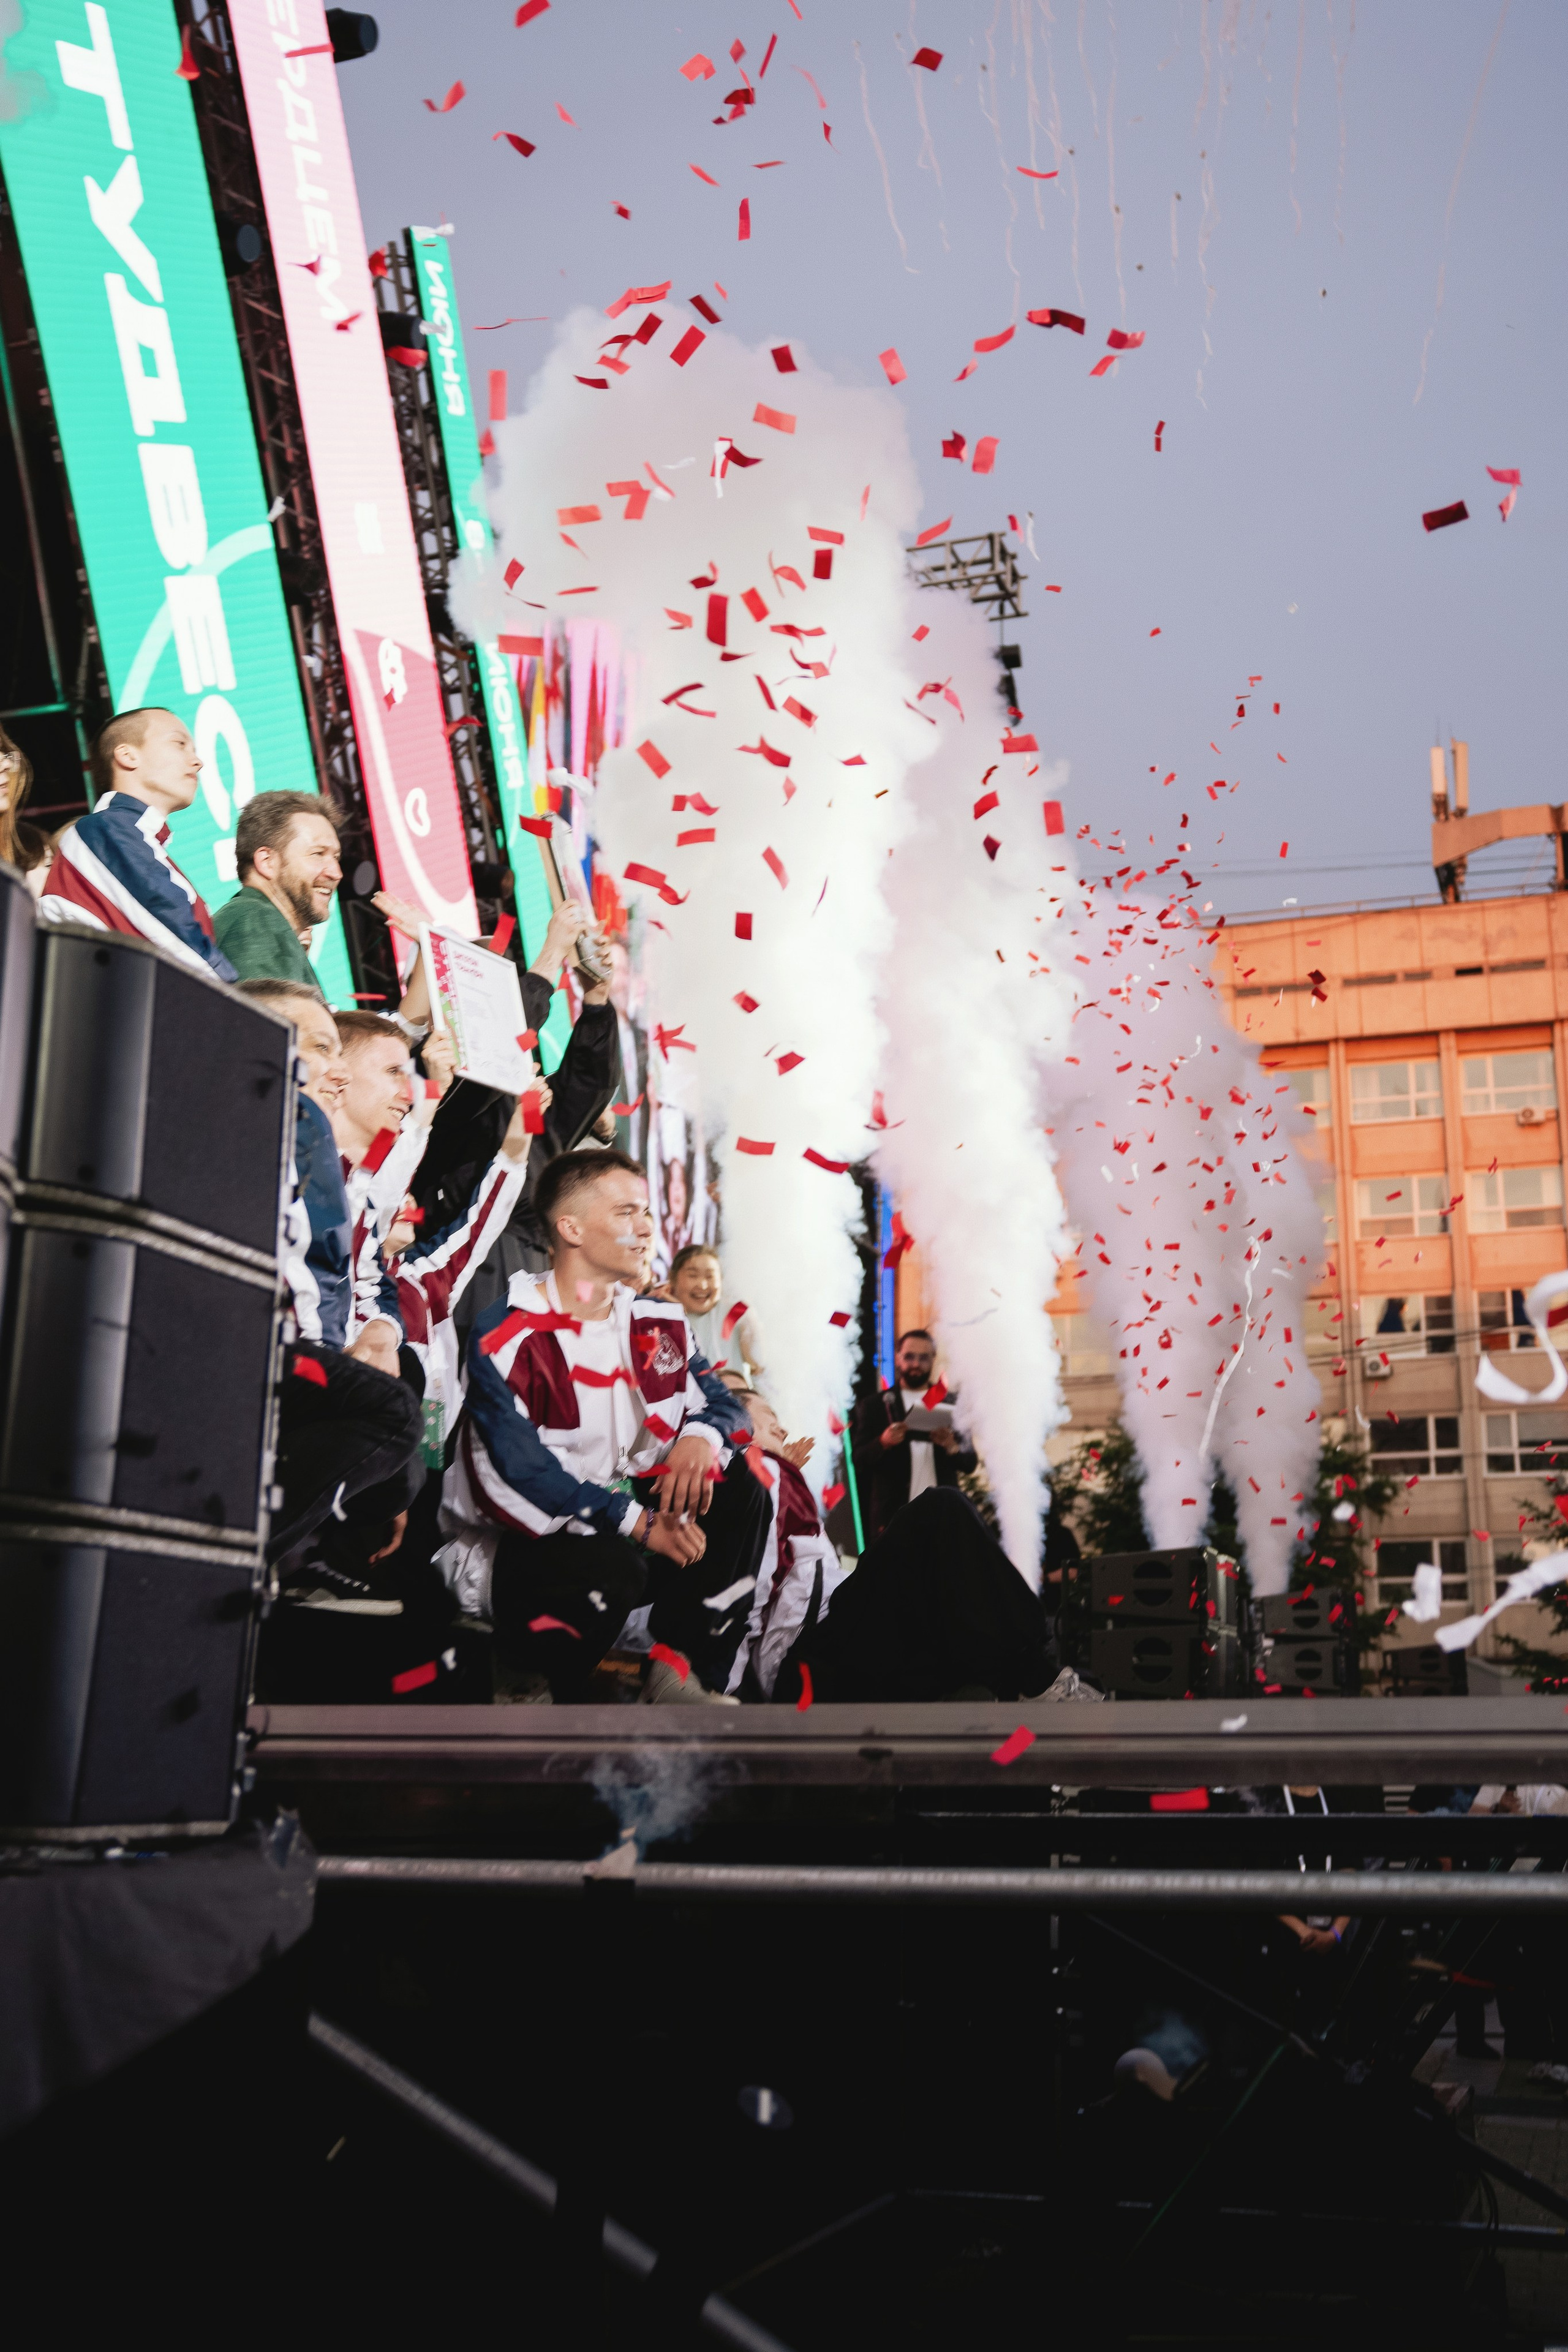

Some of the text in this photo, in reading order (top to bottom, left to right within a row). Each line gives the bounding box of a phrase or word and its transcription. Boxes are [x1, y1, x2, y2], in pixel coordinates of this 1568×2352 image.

[424, 261, 465, 417] ИЮНЯ
[56, 2, 255, 881] ТУДВЕС
[483, 643, 526, 789] ИЮНЯ
